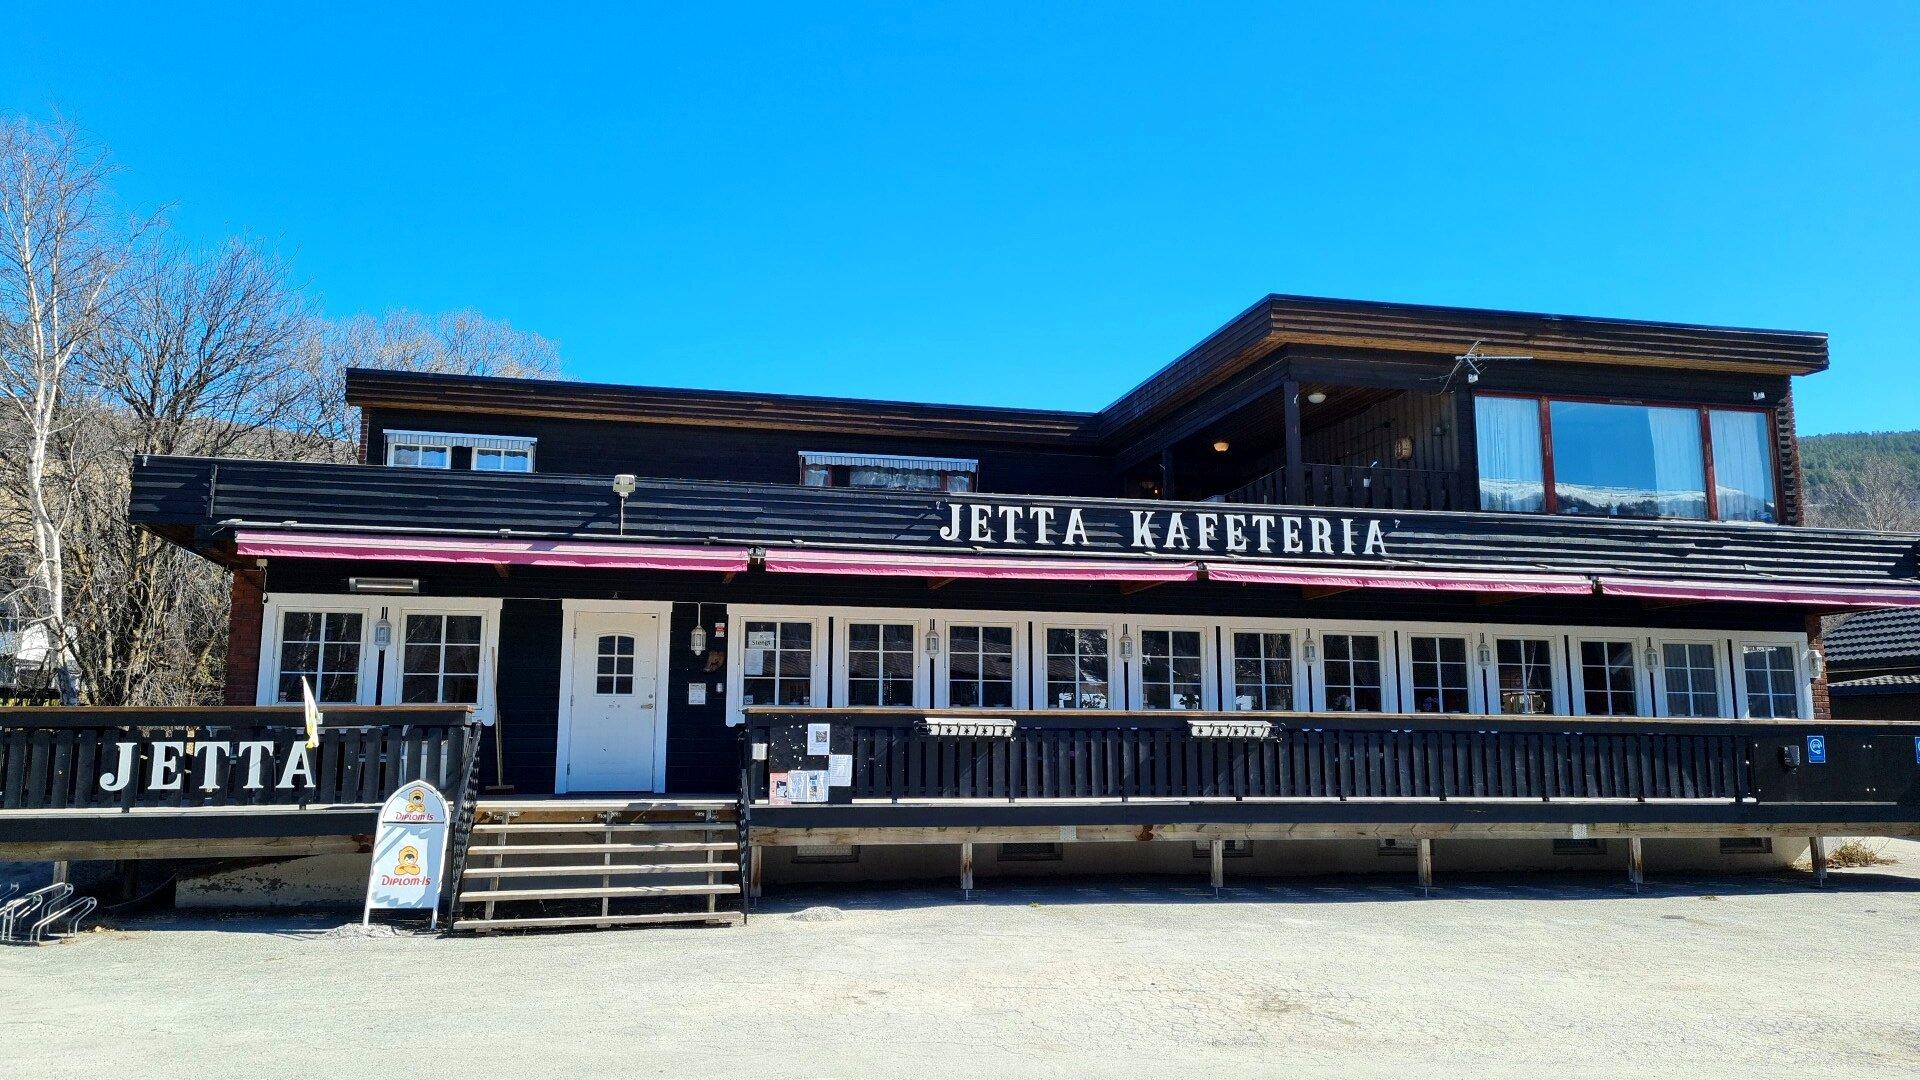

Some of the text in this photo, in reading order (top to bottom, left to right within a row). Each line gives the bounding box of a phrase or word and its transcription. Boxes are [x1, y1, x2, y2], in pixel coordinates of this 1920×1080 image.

[939, 504, 1389, 556] JETTA KAFETERIA
[99, 741, 316, 792] JETTA
